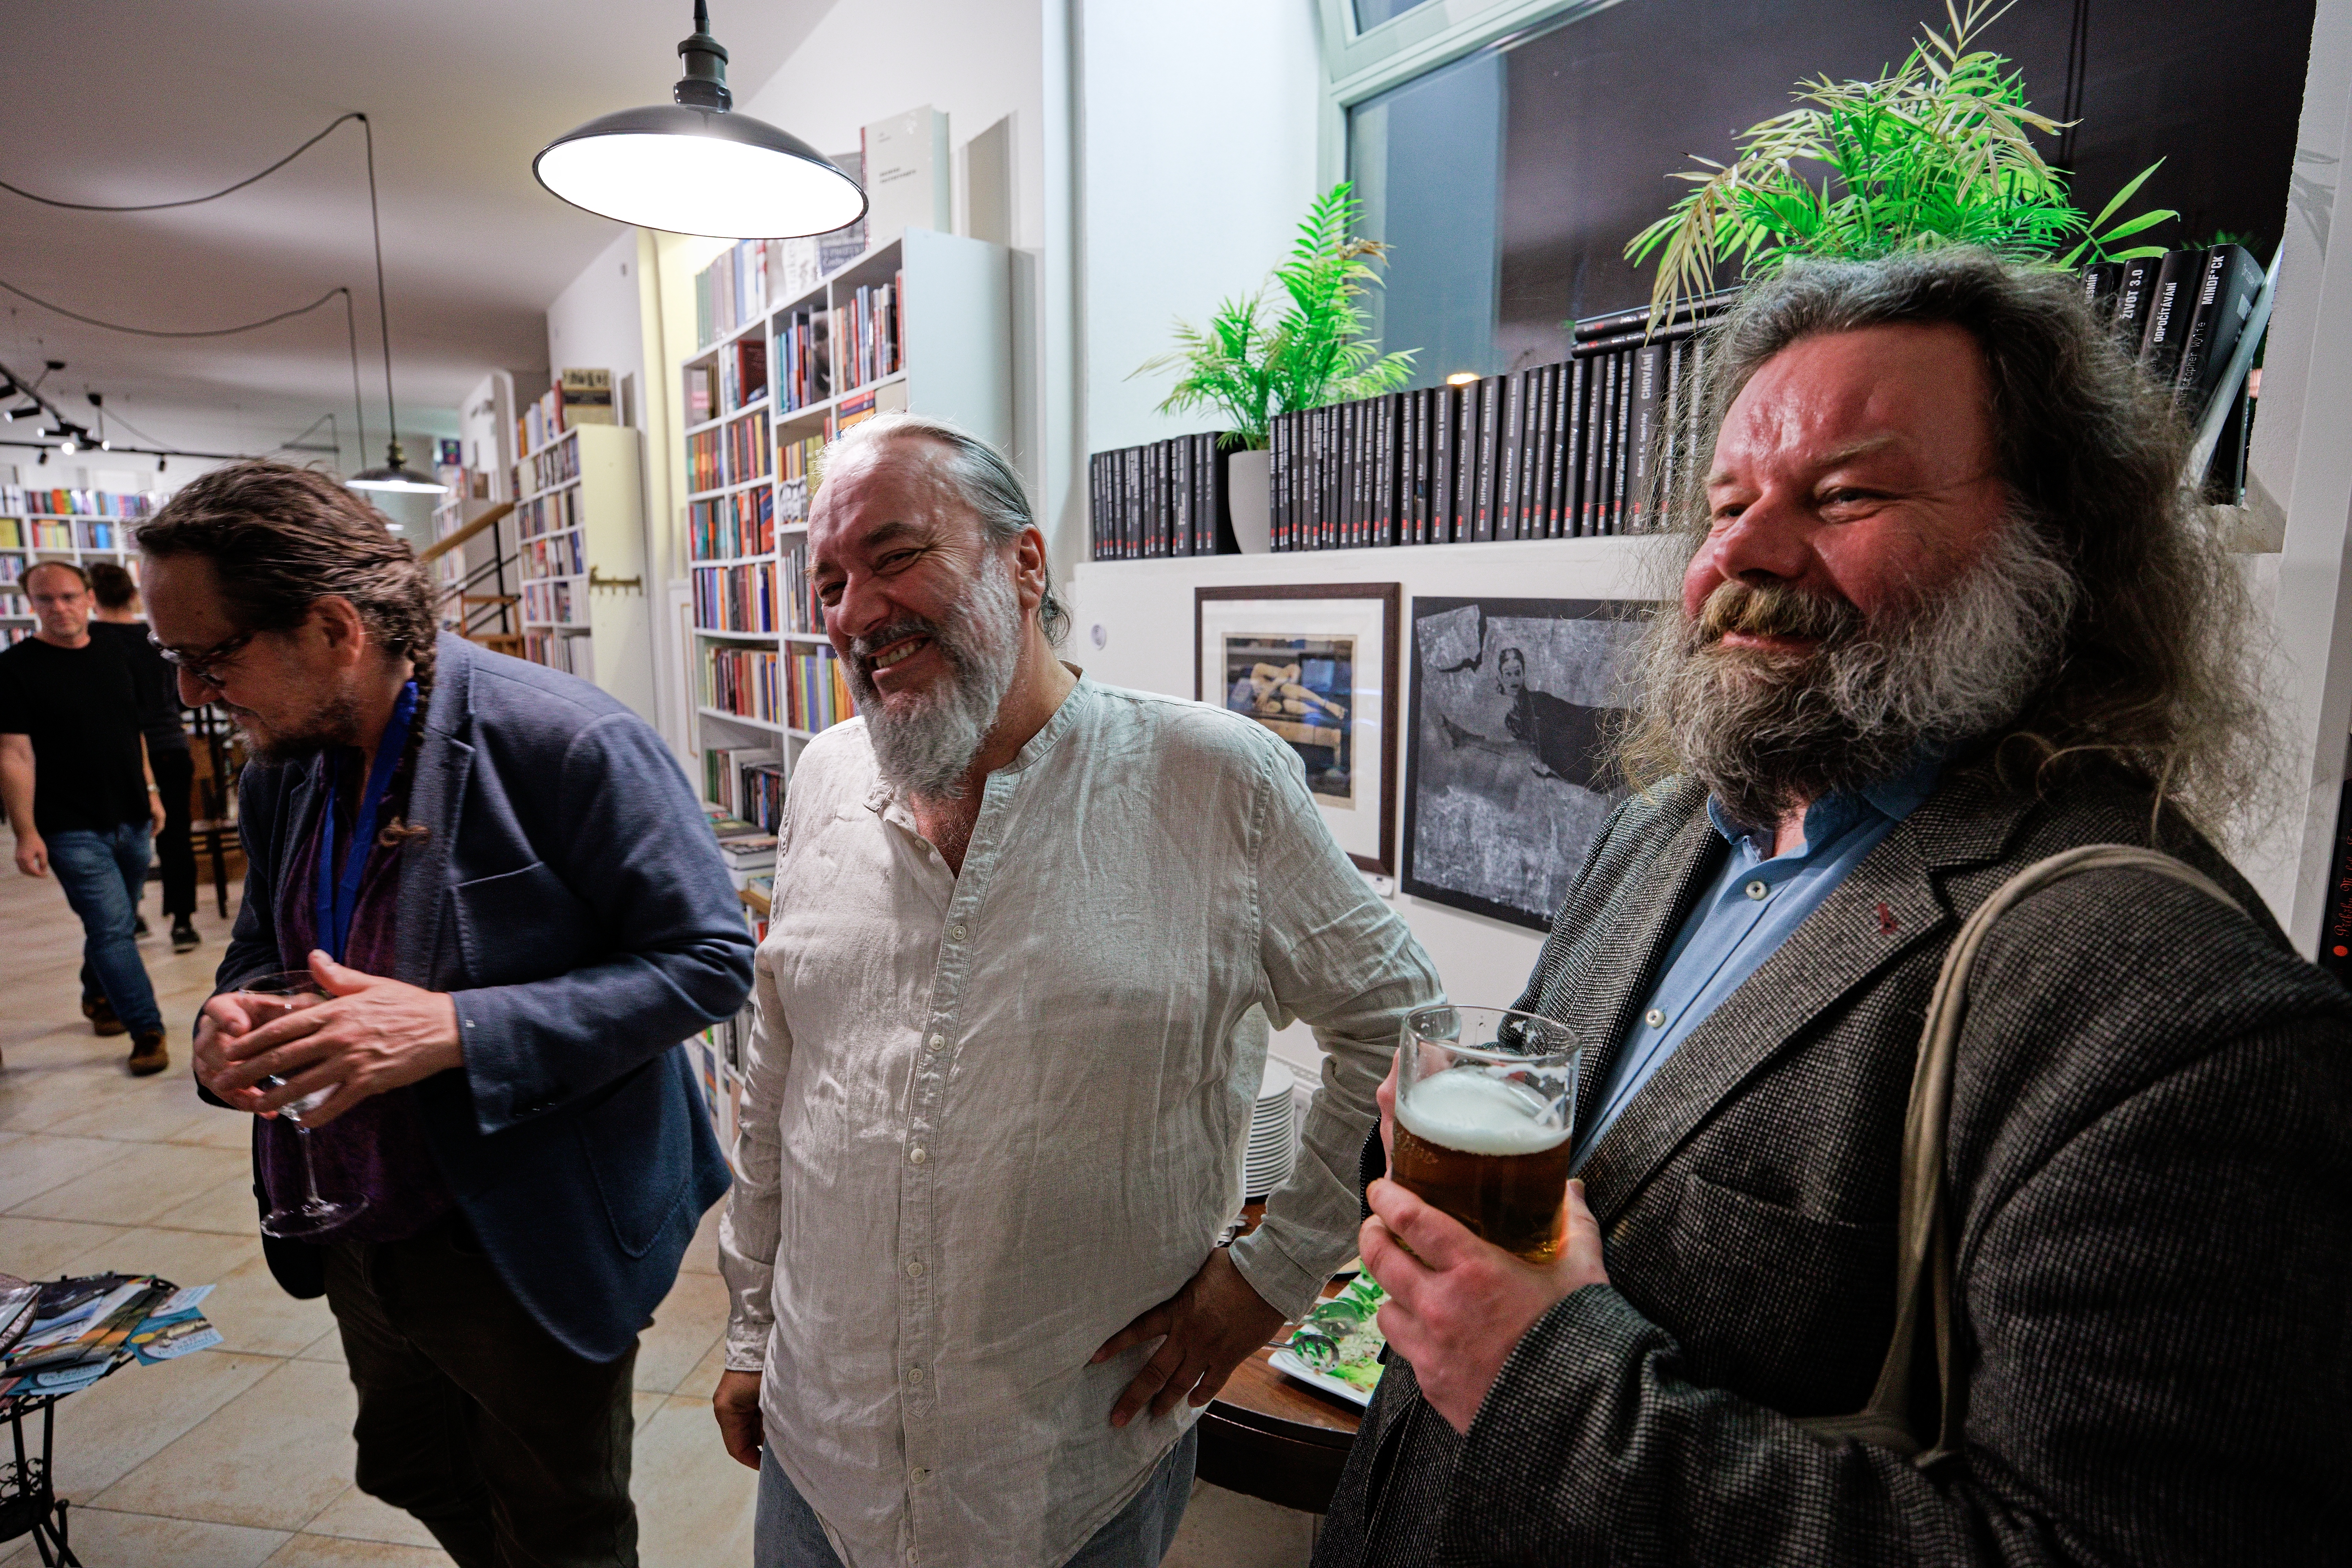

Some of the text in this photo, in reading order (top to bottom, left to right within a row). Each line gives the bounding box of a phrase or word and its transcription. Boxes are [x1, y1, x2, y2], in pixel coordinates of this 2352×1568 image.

[2119, 269, 2143, 319] ŽIVOT 3.0
[2154, 282, 2177, 342] ODPOČÍTÁVÁNÍ
[2191, 321, 2206, 348] Wylie
[1572, 366, 1581, 421] EVOLUCE VŠEHO
[1642, 354, 1653, 399] CHOVÁNÍ
[1620, 396, 1628, 430] POČÁTKU
[1619, 432, 1626, 443] NA
